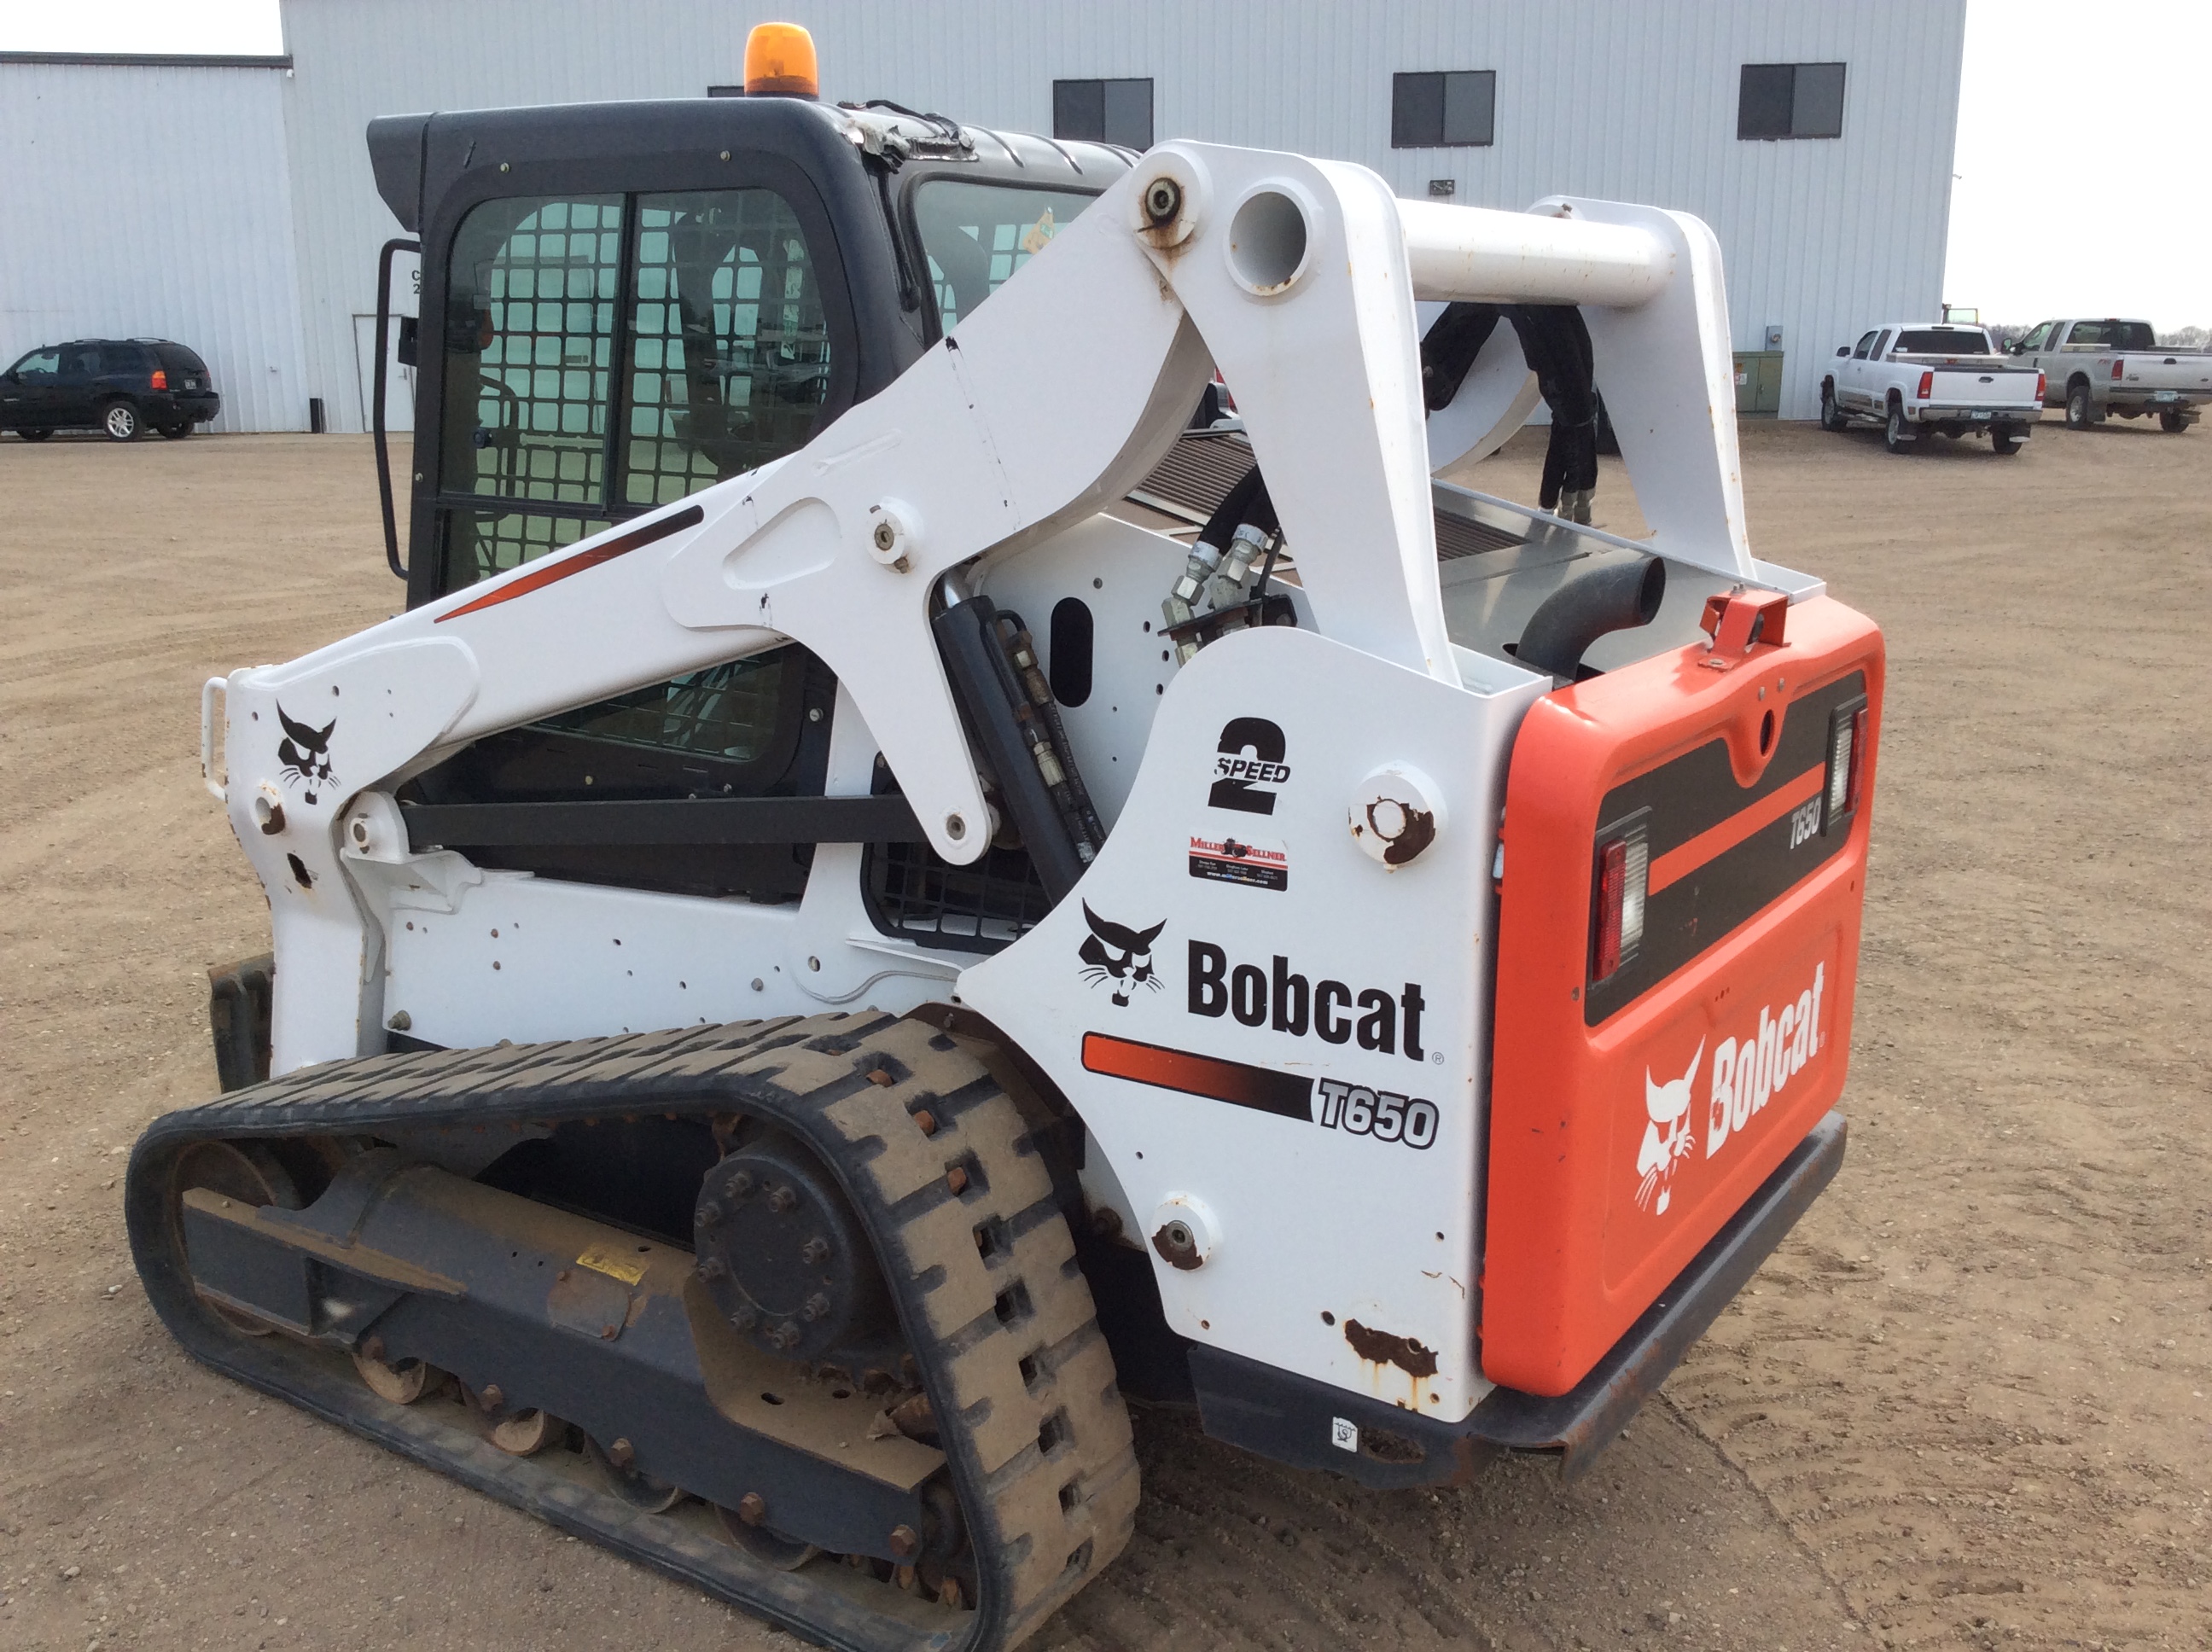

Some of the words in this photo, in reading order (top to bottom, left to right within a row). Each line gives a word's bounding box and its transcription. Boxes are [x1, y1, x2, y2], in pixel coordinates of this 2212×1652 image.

[1214, 757, 1291, 783] SPEED
[1790, 797, 1822, 848] T650
[1188, 939, 1425, 1061] Bobcat
[1706, 961, 1825, 1160] Bobcat
[1318, 1077, 1440, 1150] T650
